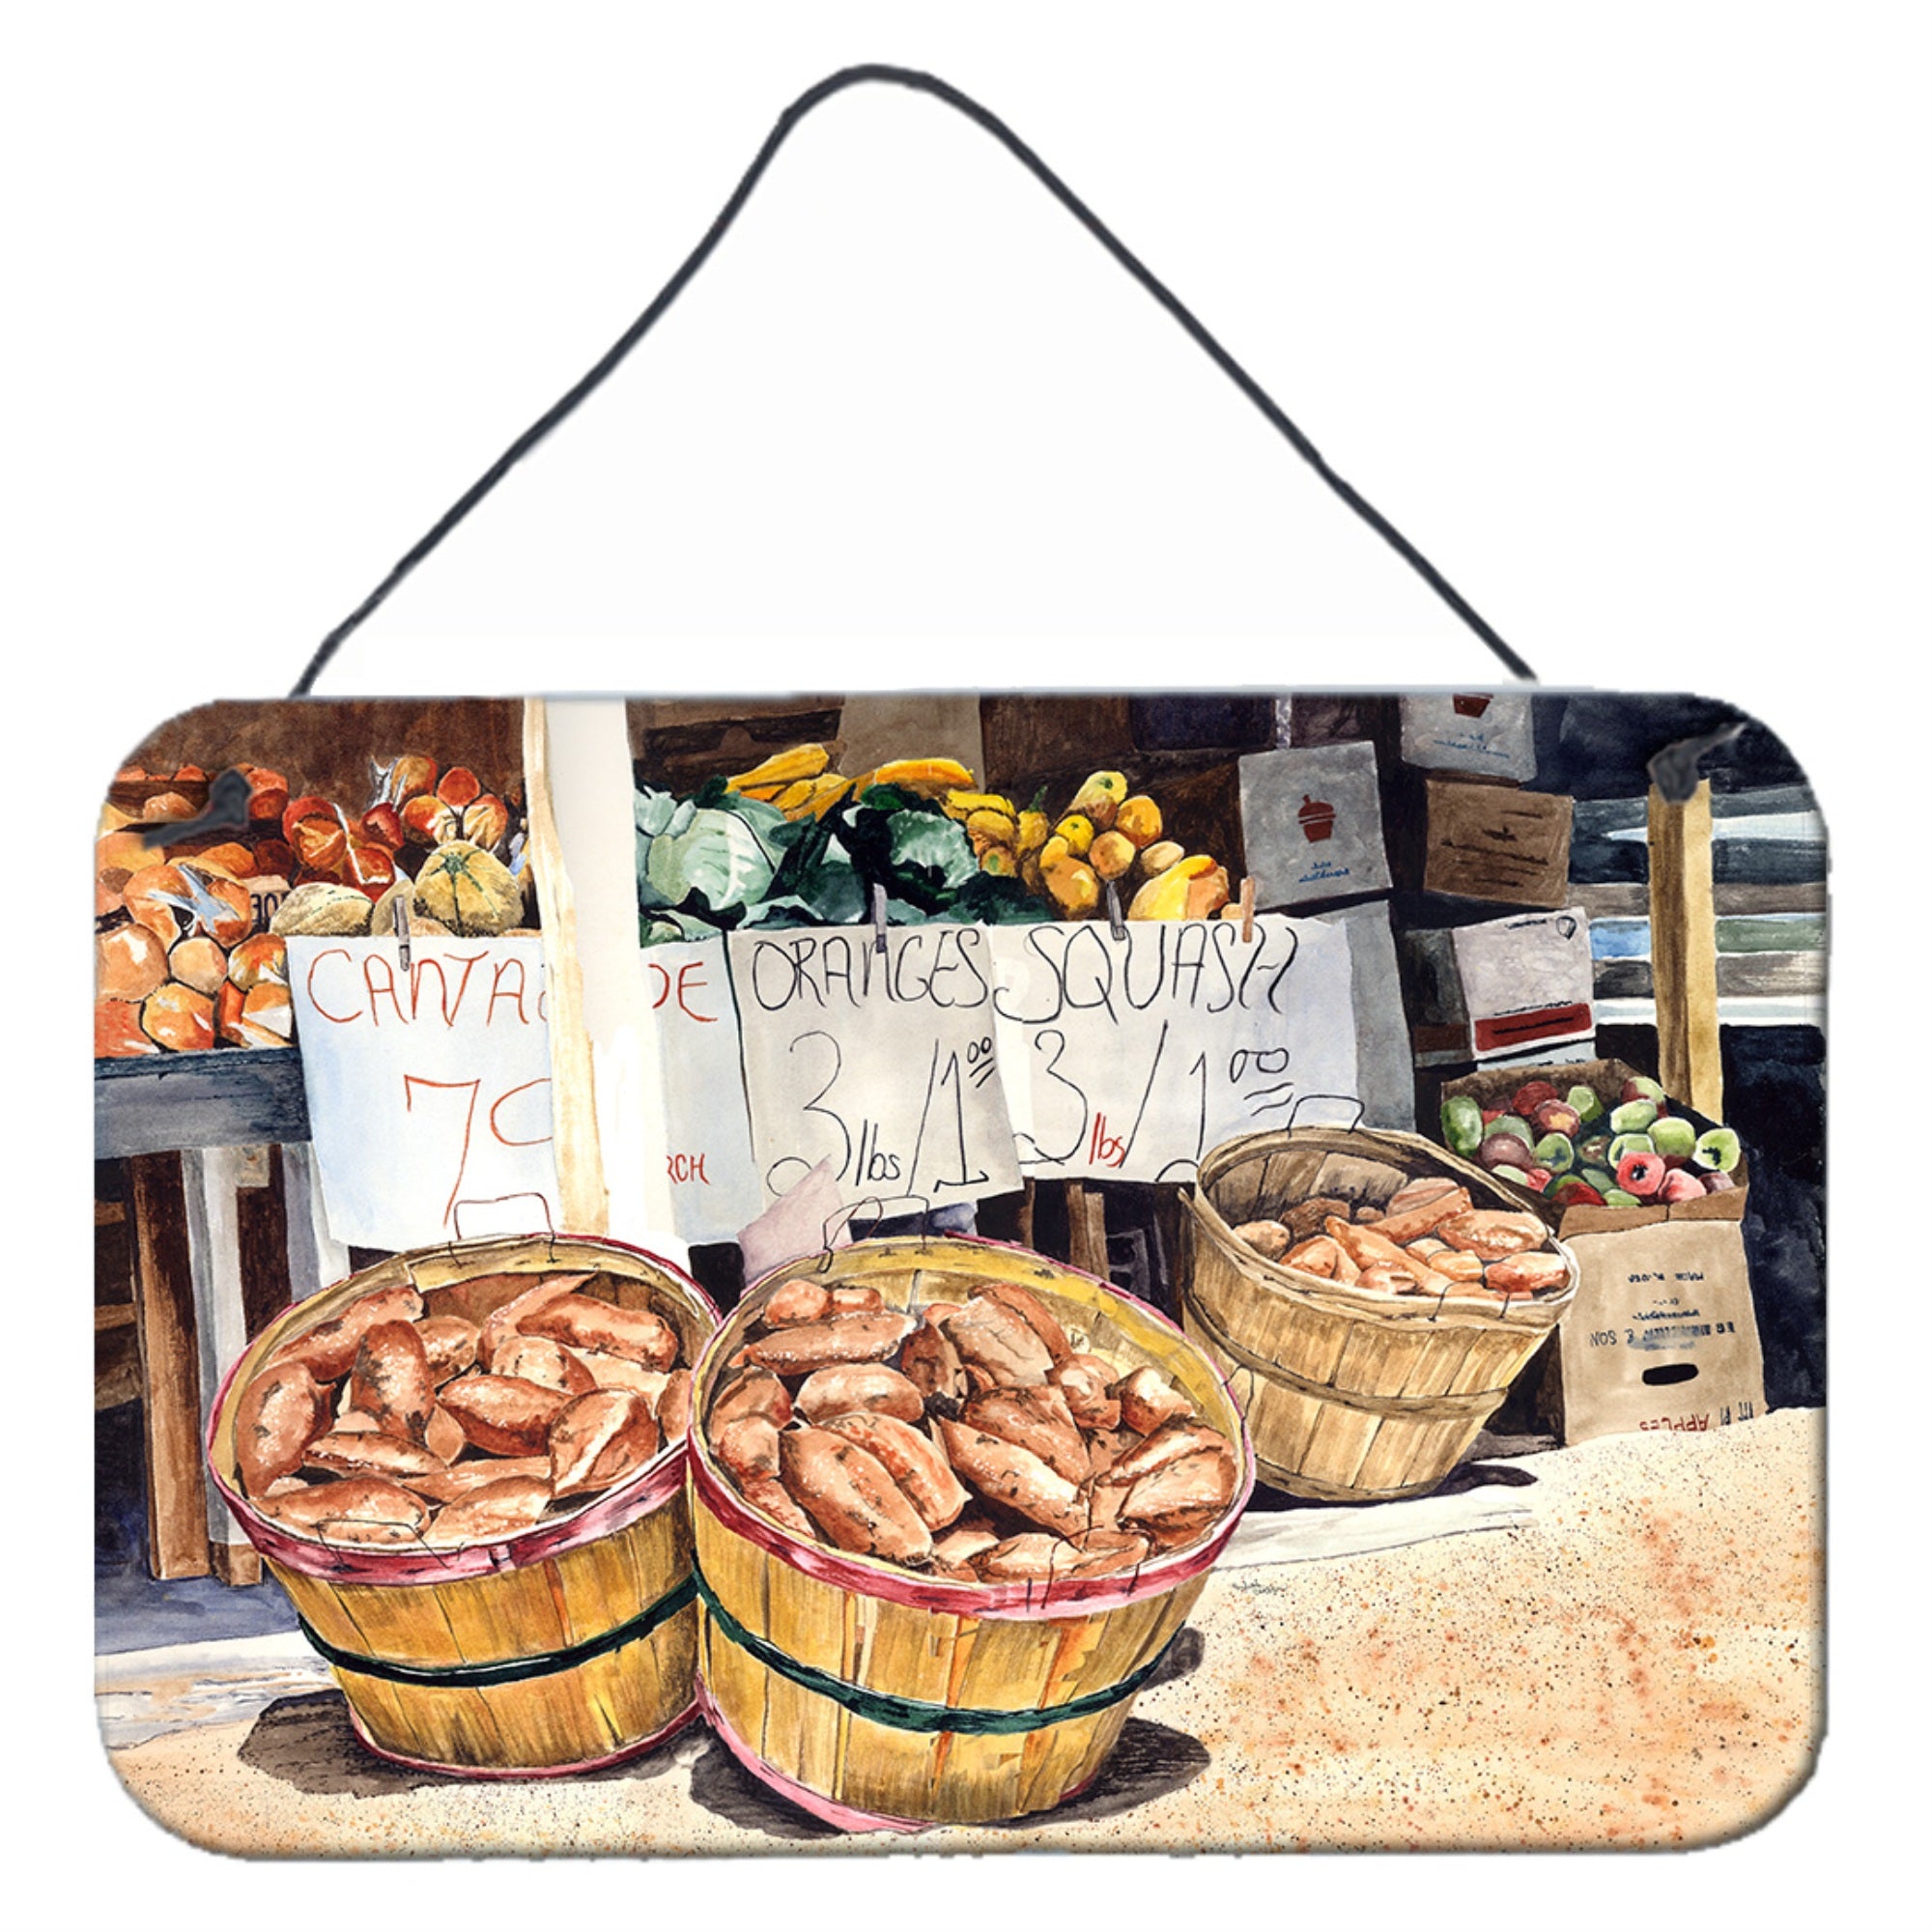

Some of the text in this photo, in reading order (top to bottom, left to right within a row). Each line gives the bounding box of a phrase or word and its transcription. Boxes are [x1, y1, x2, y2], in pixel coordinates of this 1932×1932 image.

[753, 928, 989, 1010] ORANGES
[993, 923, 1299, 1025] SQUASH
[1589, 1329, 1618, 1350] SON
